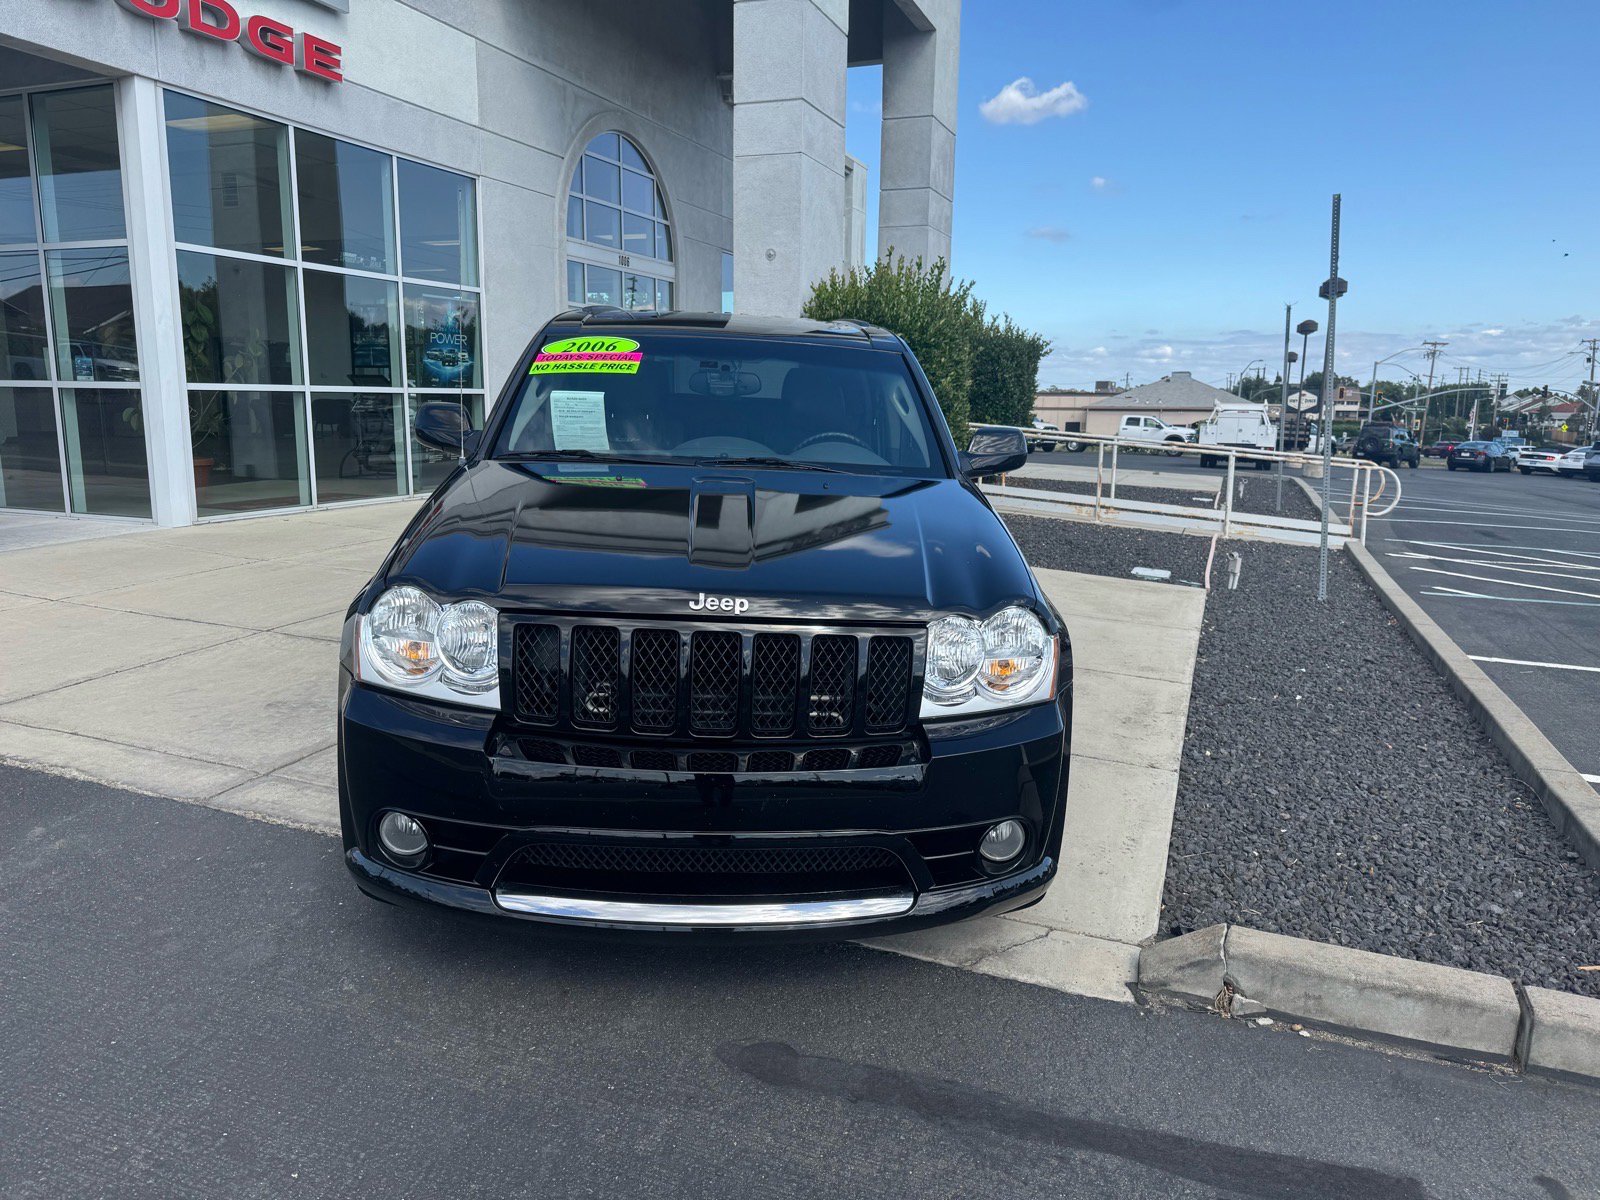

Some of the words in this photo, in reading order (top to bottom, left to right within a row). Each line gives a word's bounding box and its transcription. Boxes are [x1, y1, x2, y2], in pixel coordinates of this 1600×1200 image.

[430, 332, 468, 345] POWER
[561, 340, 621, 353] 2006
[540, 353, 584, 362] TODAYS
[586, 352, 634, 361] SPECIAL
[688, 592, 749, 615] Jeep
